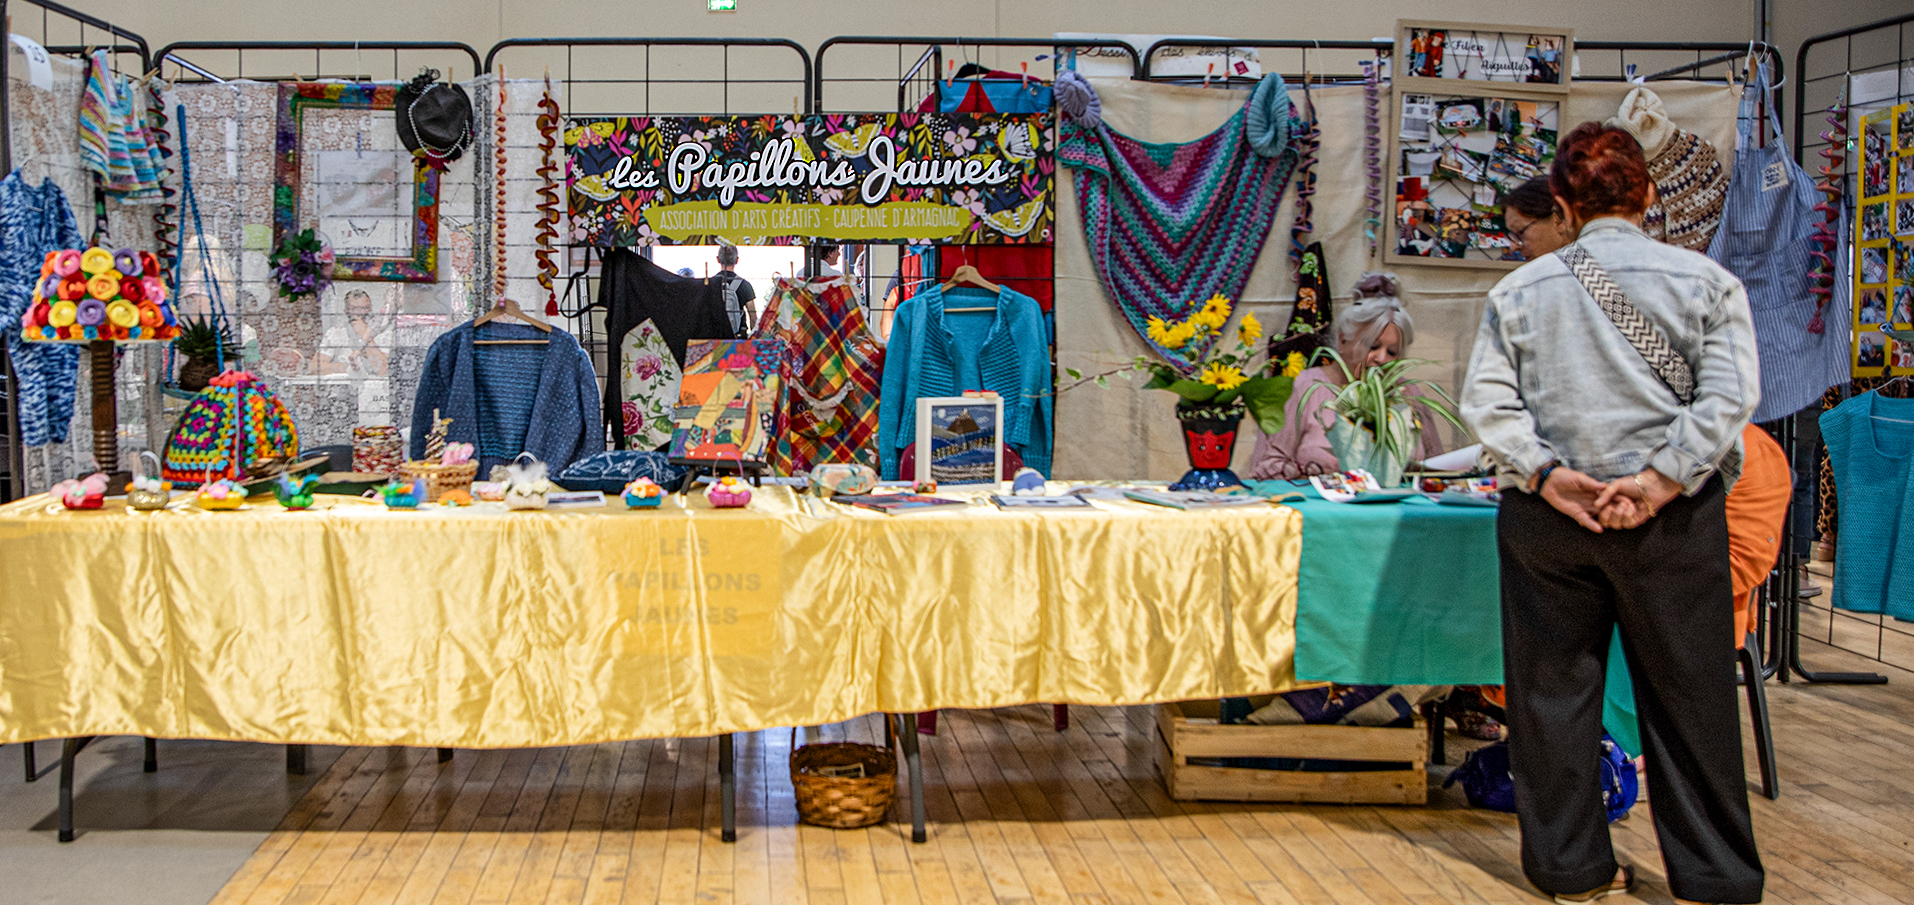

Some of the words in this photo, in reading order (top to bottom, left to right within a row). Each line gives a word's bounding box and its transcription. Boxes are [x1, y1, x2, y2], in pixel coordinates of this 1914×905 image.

[667, 138, 856, 207] Papillons
[861, 135, 1009, 204] Jaunes
[660, 210, 727, 230] ASSOCIATION
[833, 207, 888, 228] CAUPENNE
